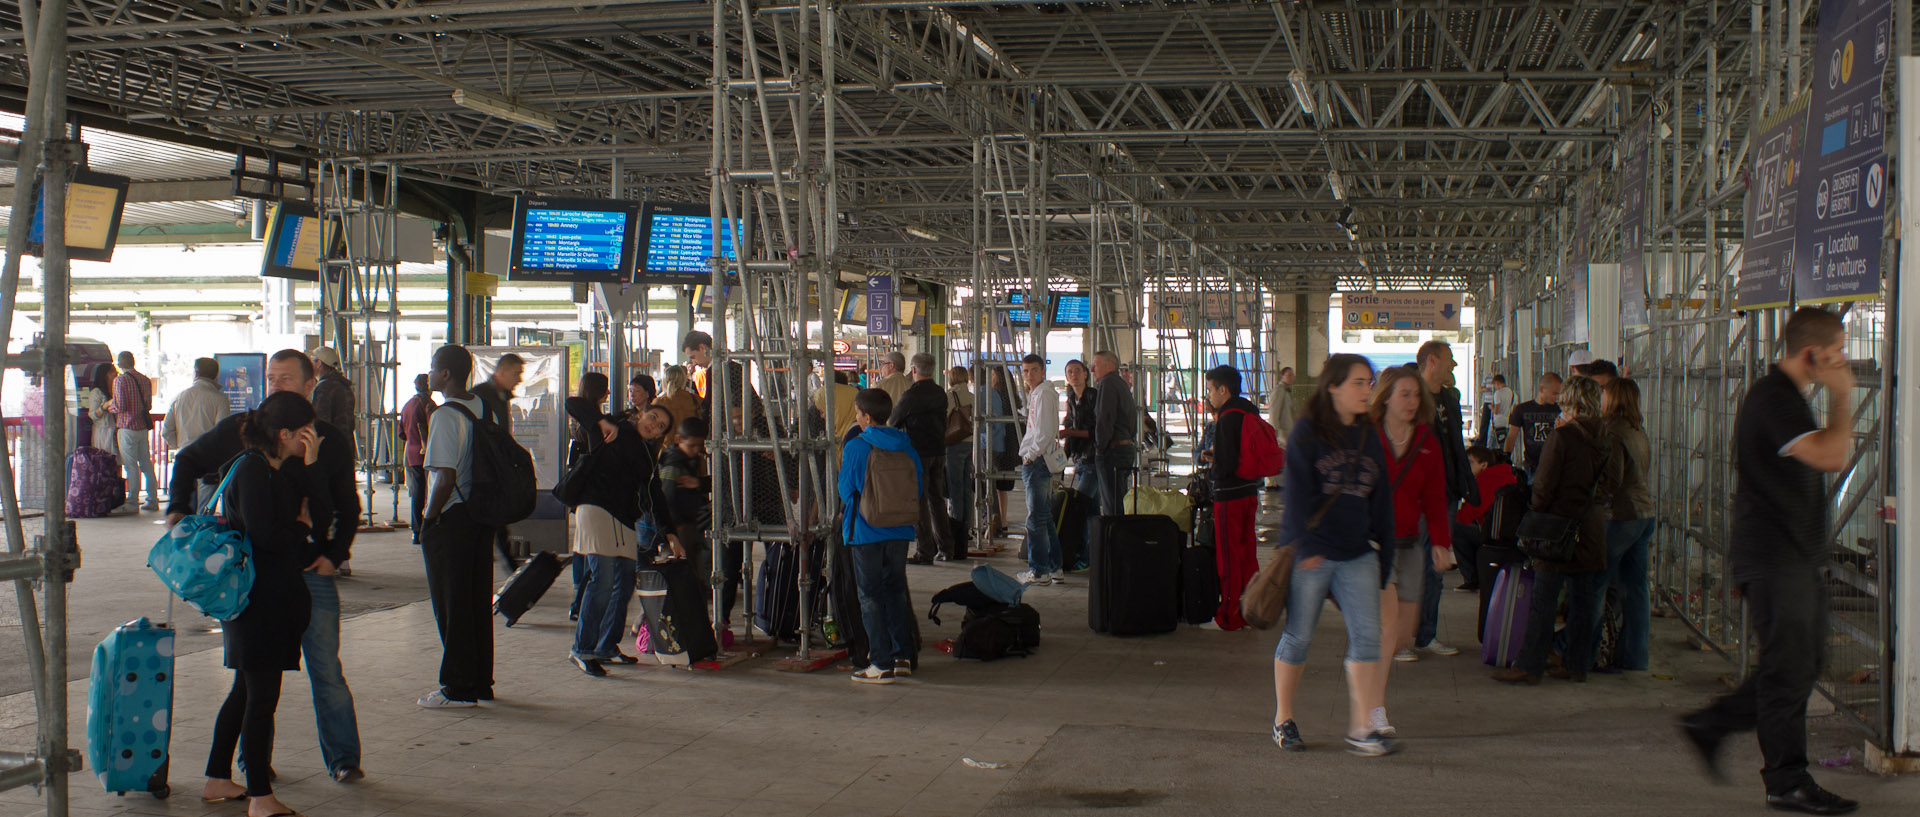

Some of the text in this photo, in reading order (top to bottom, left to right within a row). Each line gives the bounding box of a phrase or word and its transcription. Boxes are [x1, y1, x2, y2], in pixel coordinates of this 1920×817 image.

[1853, 119, 1860, 140] A
[1872, 110, 1880, 132] N
[1845, 175, 1851, 188] 57
[1851, 173, 1858, 187] 61
[1868, 170, 1880, 202] N
[1817, 192, 1828, 207] BUS
[1843, 196, 1850, 210] 91
[1828, 231, 1859, 255] Location
[1826, 255, 1867, 279] de voitures
[876, 300, 882, 308] 7
[1347, 295, 1379, 304] Sortie
[1382, 297, 1435, 306] Parvis de la gare
[876, 321, 882, 330] 9
[1533, 422, 1550, 442] K
